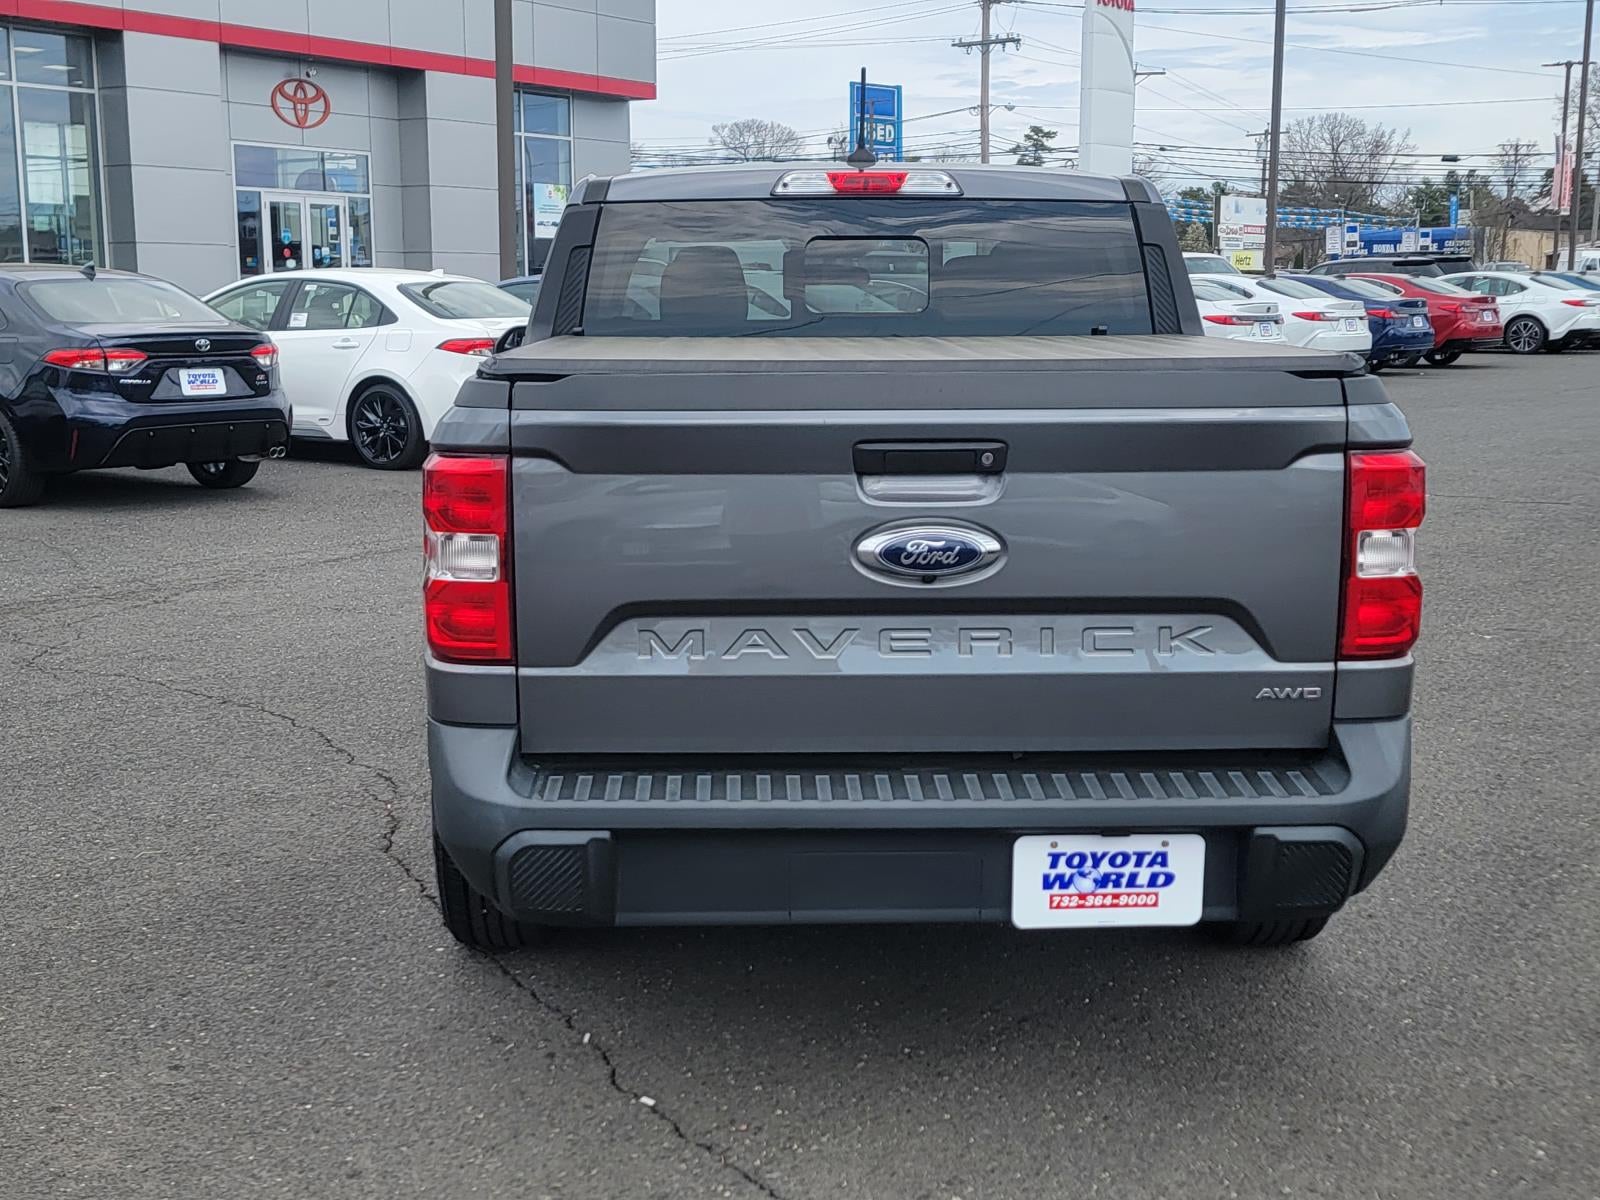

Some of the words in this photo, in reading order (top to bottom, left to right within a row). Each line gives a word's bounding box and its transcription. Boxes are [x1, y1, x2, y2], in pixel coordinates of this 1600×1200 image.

[1235, 254, 1252, 266] Hertz
[900, 539, 961, 565] Ford
[637, 625, 1216, 660] MAVERICK
[1255, 687, 1322, 699] AWD
[1047, 851, 1169, 870] TOYOTA
[1042, 869, 1176, 892] WORLD
[1051, 894, 1156, 908] 732-364-9000
